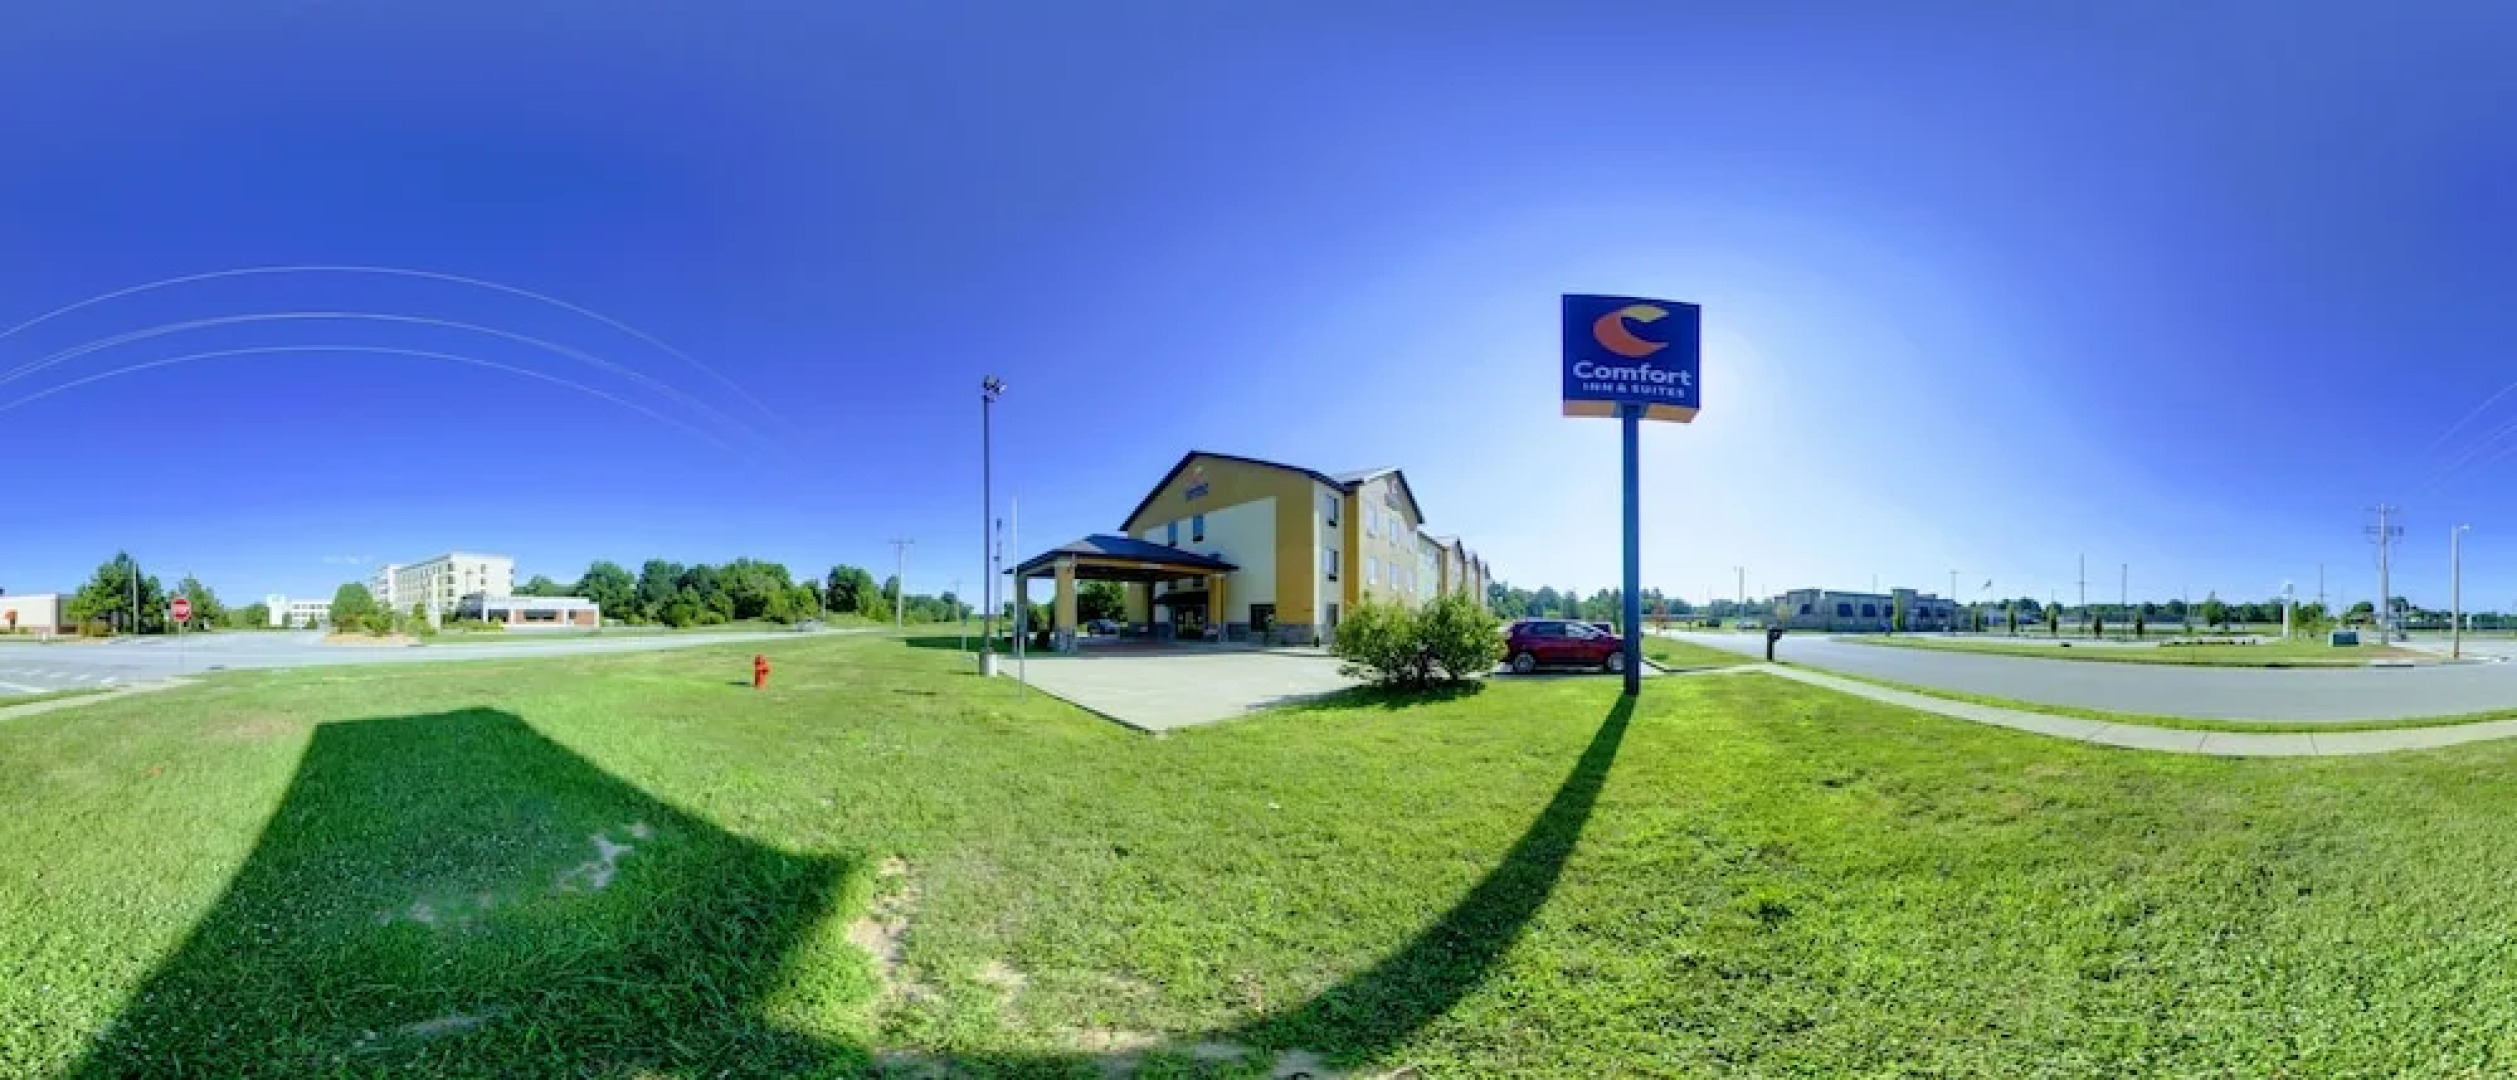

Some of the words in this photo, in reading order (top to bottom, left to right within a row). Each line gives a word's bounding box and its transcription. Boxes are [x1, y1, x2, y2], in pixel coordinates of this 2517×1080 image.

[1573, 360, 1692, 386] Comfort
[1582, 381, 1614, 391] INN
[1616, 383, 1627, 393] &
[1631, 384, 1685, 398] SUITES
